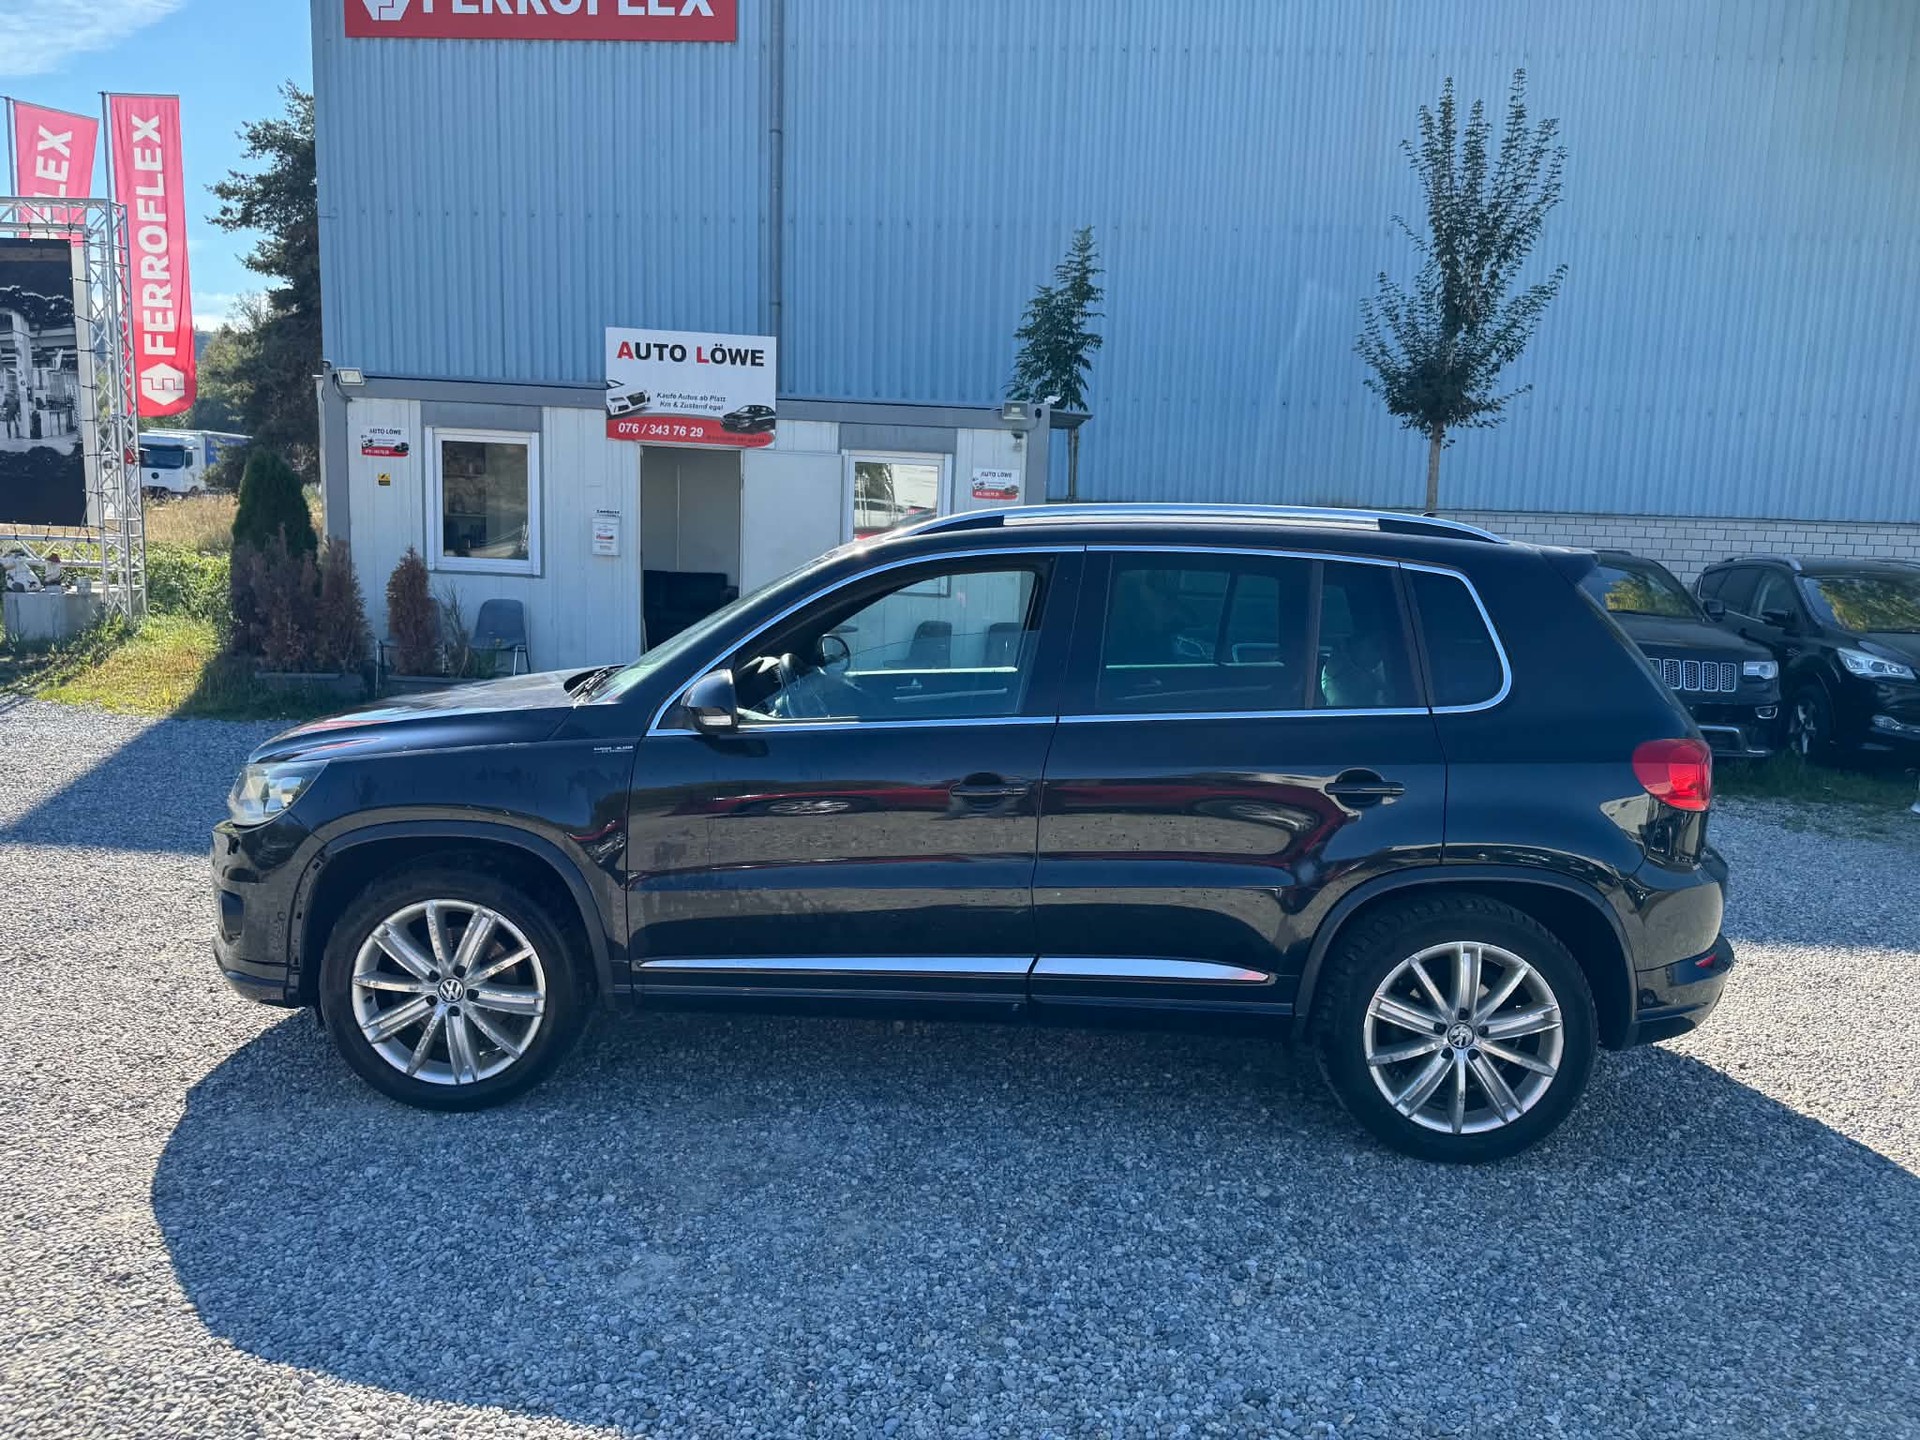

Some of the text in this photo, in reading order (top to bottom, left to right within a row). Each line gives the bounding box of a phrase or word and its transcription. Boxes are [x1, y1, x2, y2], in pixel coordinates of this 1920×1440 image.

[131, 114, 176, 356] FERROFLEX
[617, 341, 764, 366] AUTO LÖWE
[618, 422, 705, 438] 076 / 343 76 29
